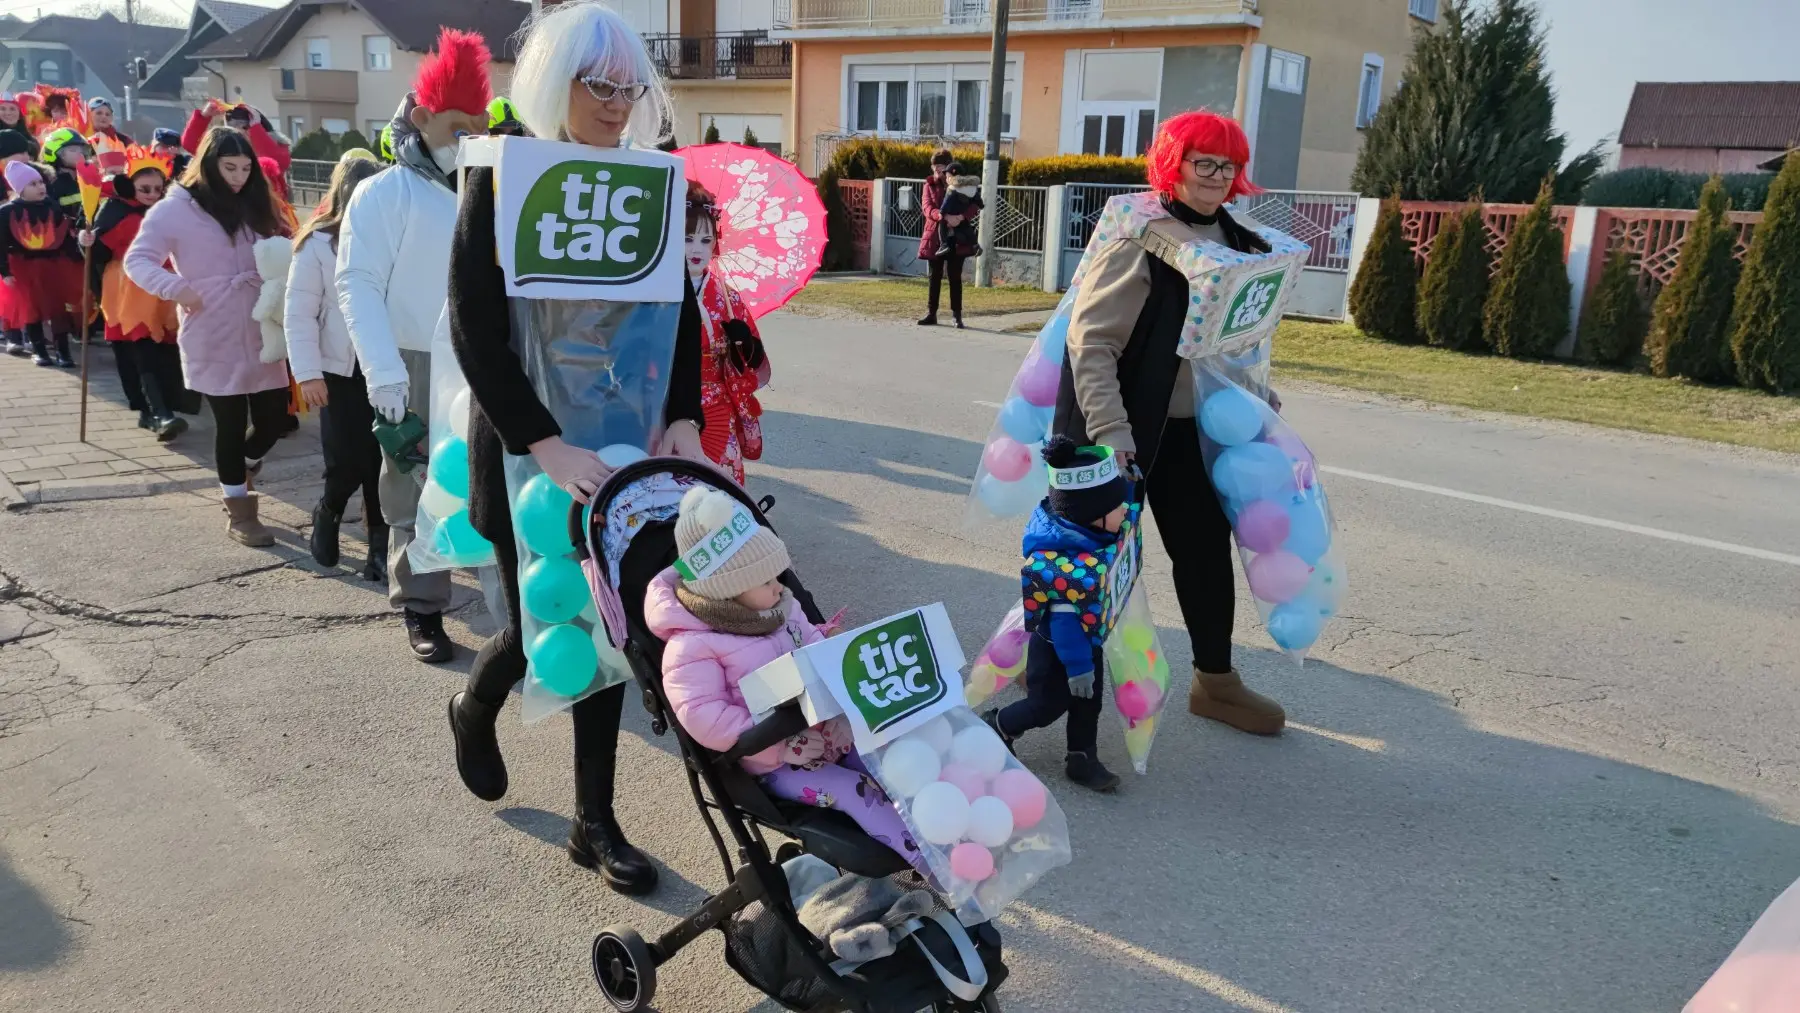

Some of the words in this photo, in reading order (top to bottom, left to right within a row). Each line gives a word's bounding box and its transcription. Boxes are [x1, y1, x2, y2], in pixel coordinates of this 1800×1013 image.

[1043, 86, 1049, 96] 7
[561, 170, 643, 223] tic
[535, 212, 640, 263] tac
[1245, 280, 1275, 307] tic
[1230, 302, 1266, 329] tac
[858, 631, 919, 680] tic
[858, 665, 931, 708] tac
